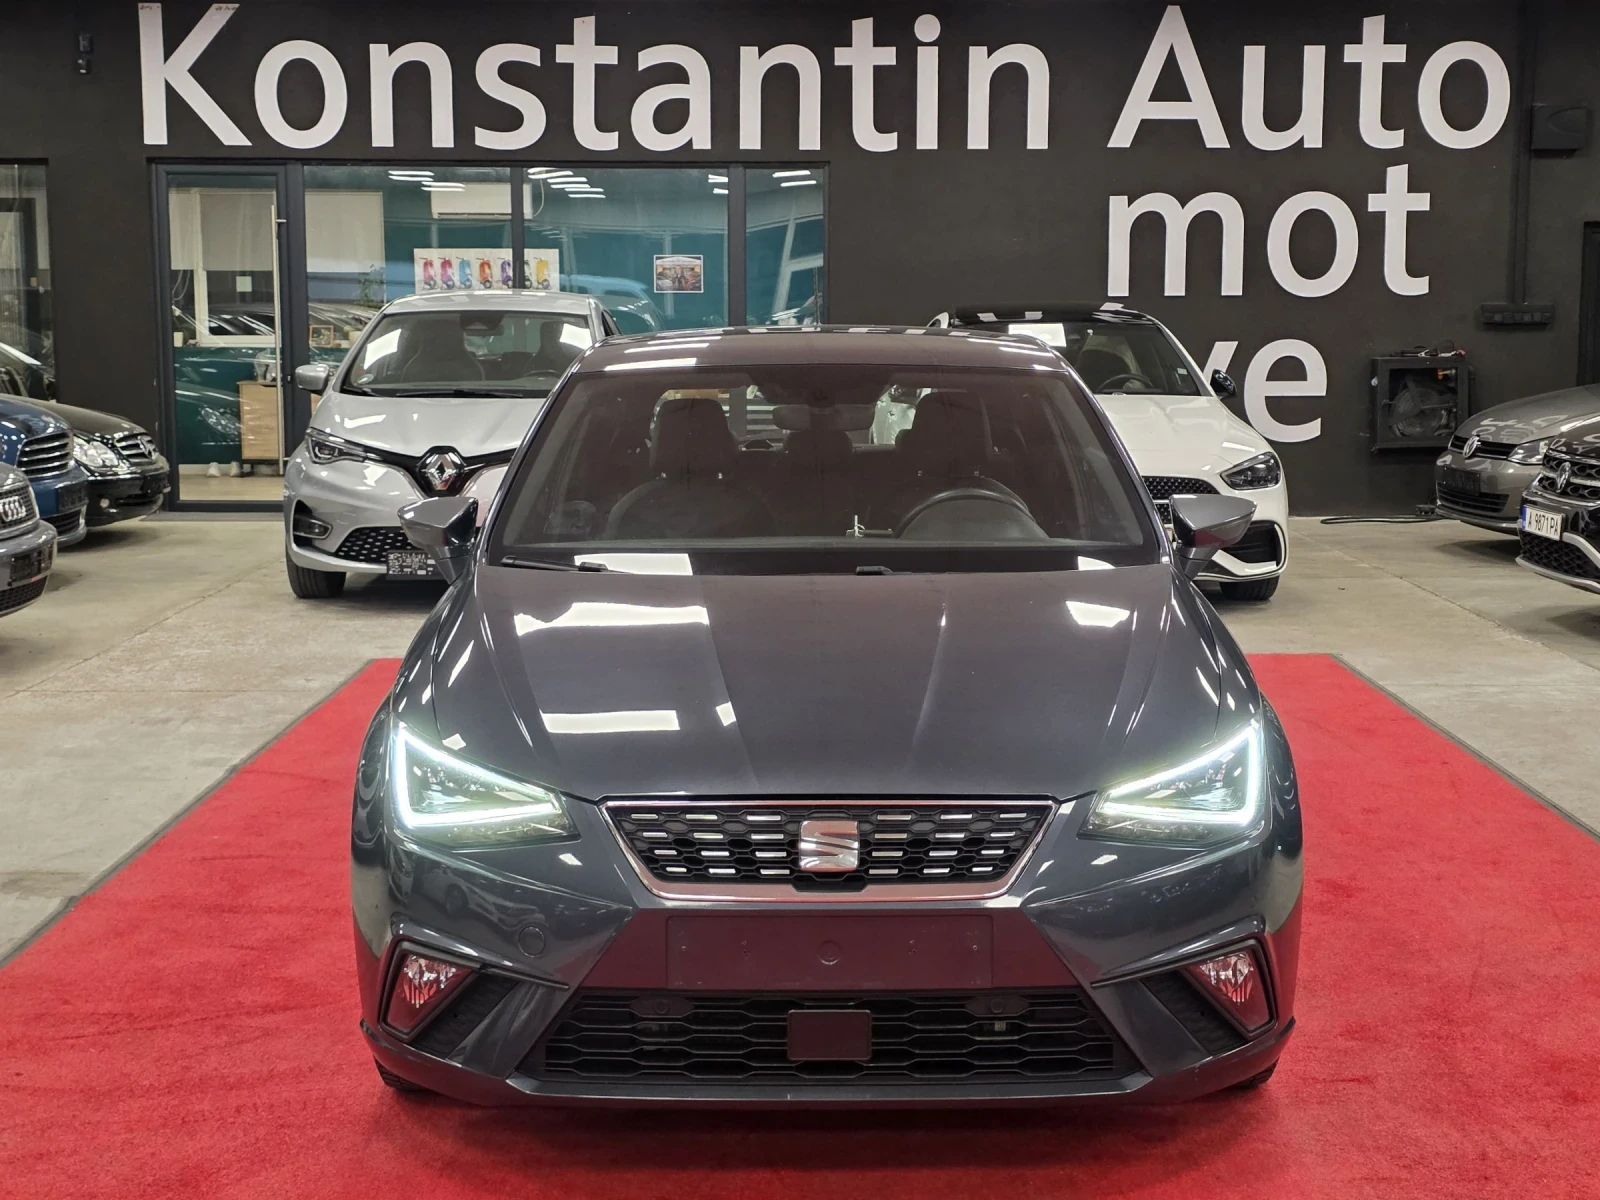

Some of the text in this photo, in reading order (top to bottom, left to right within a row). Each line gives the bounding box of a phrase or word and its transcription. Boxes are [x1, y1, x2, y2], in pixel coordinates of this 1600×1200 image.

[139, 4, 1511, 153] Konstantin Auto
[1108, 164, 1431, 298] mot
